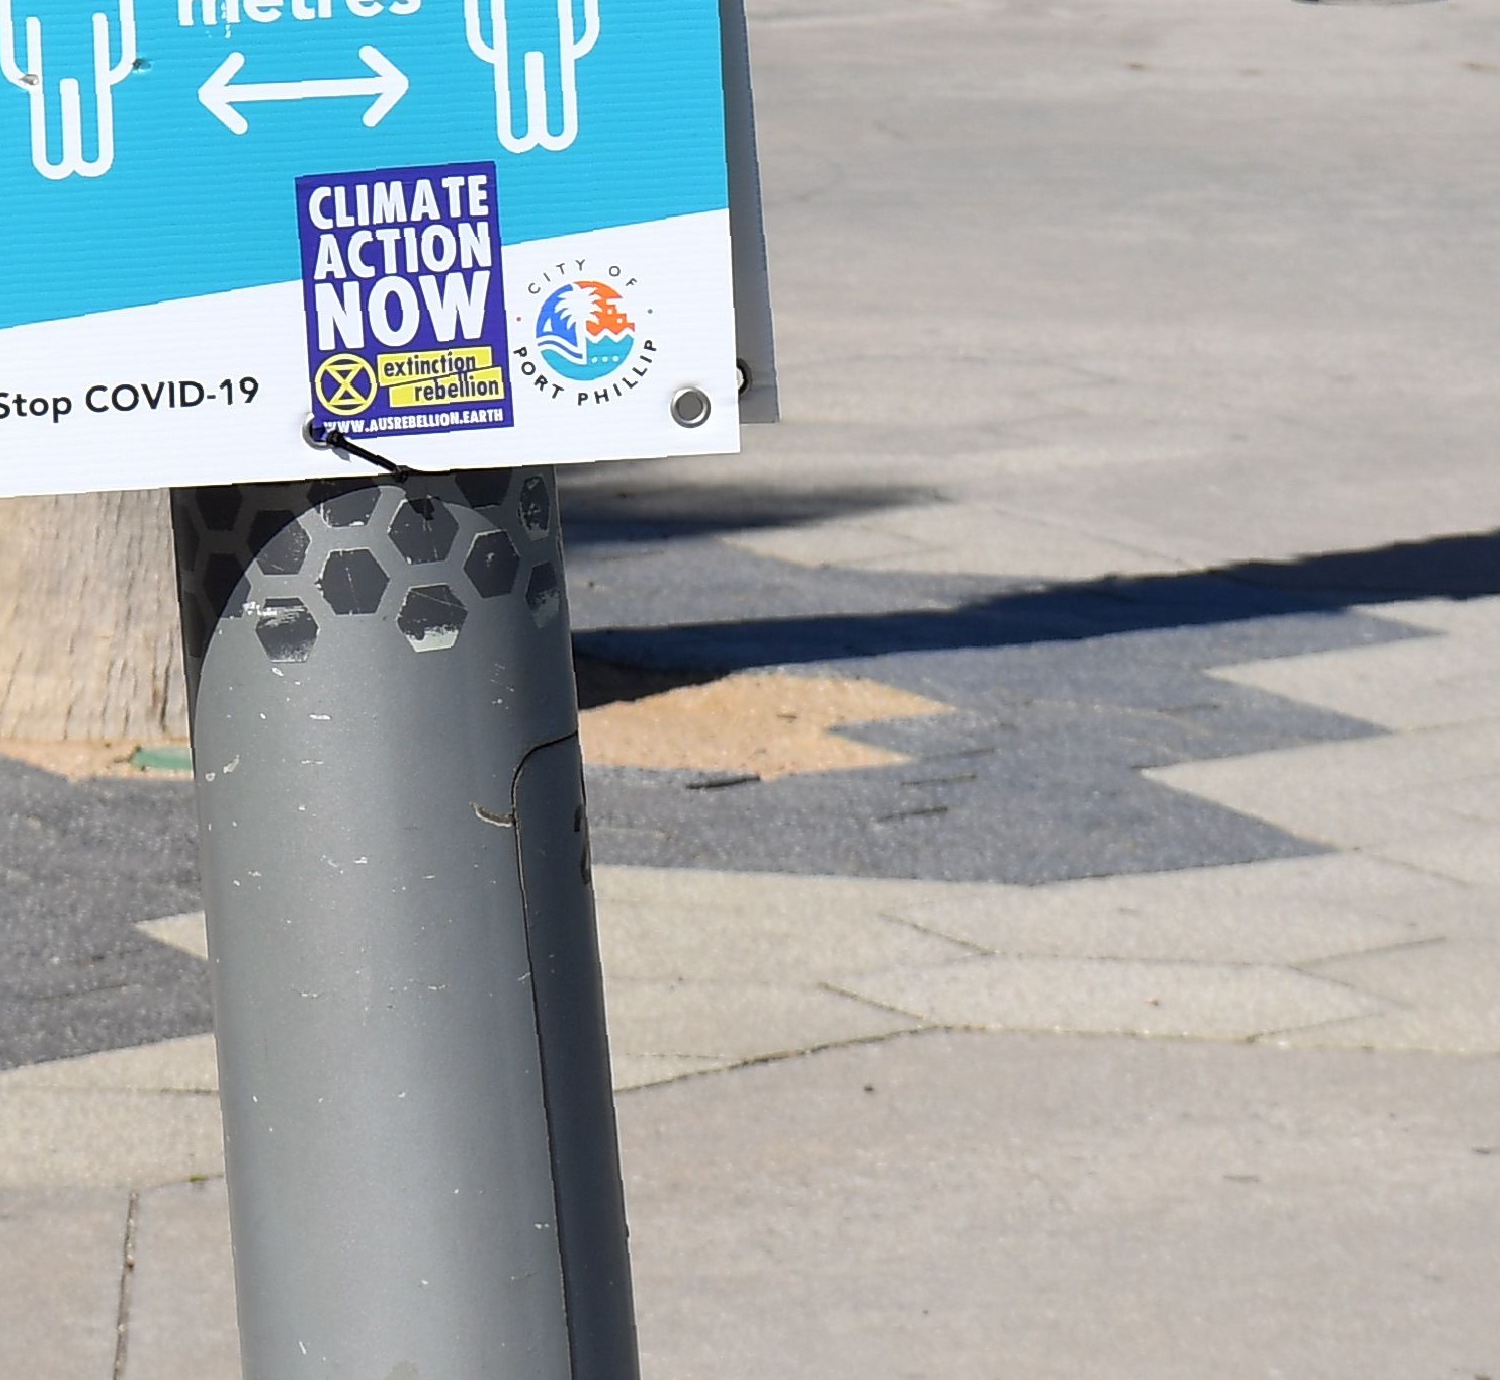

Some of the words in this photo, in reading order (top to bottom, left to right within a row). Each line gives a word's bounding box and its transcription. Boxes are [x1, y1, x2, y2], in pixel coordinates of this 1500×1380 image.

[309, 175, 489, 230] CLIMATE
[314, 222, 492, 280] ACTION
[527, 259, 586, 295] CITY
[608, 265, 638, 287] OF
[314, 270, 491, 351] NOW
[383, 352, 476, 378] extinction
[513, 346, 565, 400] PORT
[577, 339, 657, 407] PHILLIP
[85, 376, 259, 413] COVID-19
[414, 372, 500, 402] rebellion
[323, 409, 504, 434] WWW.AUSREBELLION.EARTH
